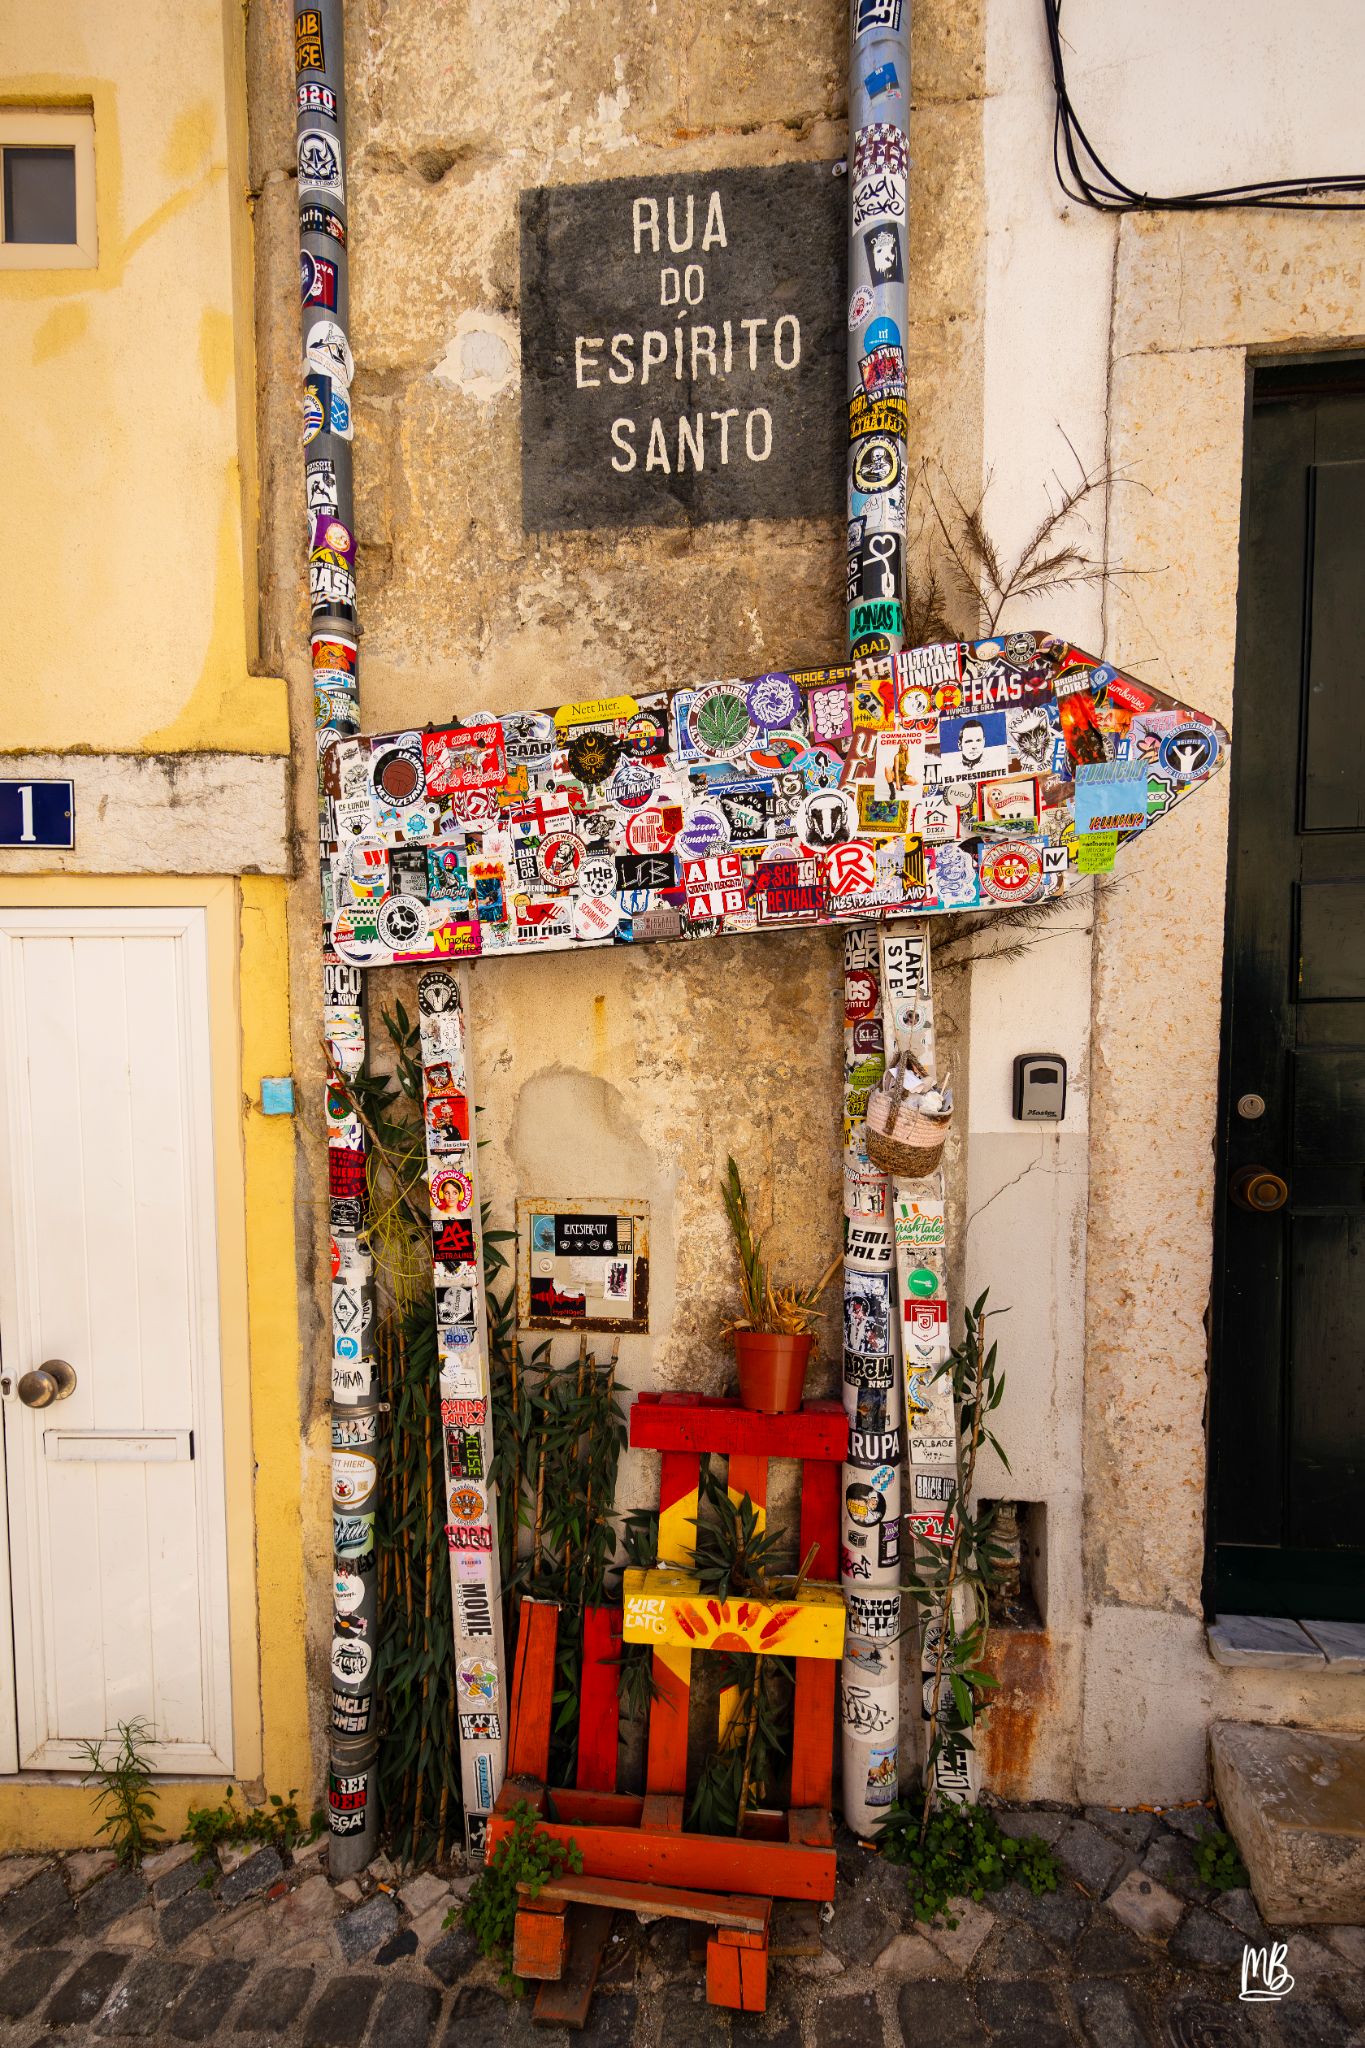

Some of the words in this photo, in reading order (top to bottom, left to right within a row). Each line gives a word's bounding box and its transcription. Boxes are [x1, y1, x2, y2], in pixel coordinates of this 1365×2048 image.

[632, 191, 727, 254] RUA
[660, 264, 705, 306] DO
[575, 309, 801, 388] ESPÍRITO
[610, 407, 773, 474] SANTO
[896, 643, 957, 673] ULTRAS
[829, 667, 852, 679] EST
[902, 661, 957, 687] UNION
[1054, 671, 1088, 686] BRIGADE
[1056, 679, 1090, 697] LOIRE
[572, 704, 596, 716] Nett
[506, 742, 552, 757] SAAR
[880, 738, 922, 746] CREATIVO
[944, 776, 955, 784] EL
[956, 768, 1007, 782] PRESIDENTE
[17, 785, 37, 841] 1
[985, 843, 1038, 866] FANCLUB
[584, 866, 613, 882] THB
[440, 1170, 460, 1180] RADIO
[431, 1176, 442, 1207] ASCOLTA
[459, 1176, 472, 1208] MAGENTA
[896, 1215, 921, 1233] irish
[921, 1217, 945, 1234] tales
[896, 1232, 914, 1245] from
[916, 1232, 943, 1243] rome
[434, 1251, 474, 1260] ASTRALINE
[446, 1333, 469, 1344] BOB
[868, 1379, 892, 1388] NMP
[442, 1412, 486, 1428] TATTOO
[343, 1459, 366, 1469] HIER!
[461, 1583, 493, 1637] MOVIE
